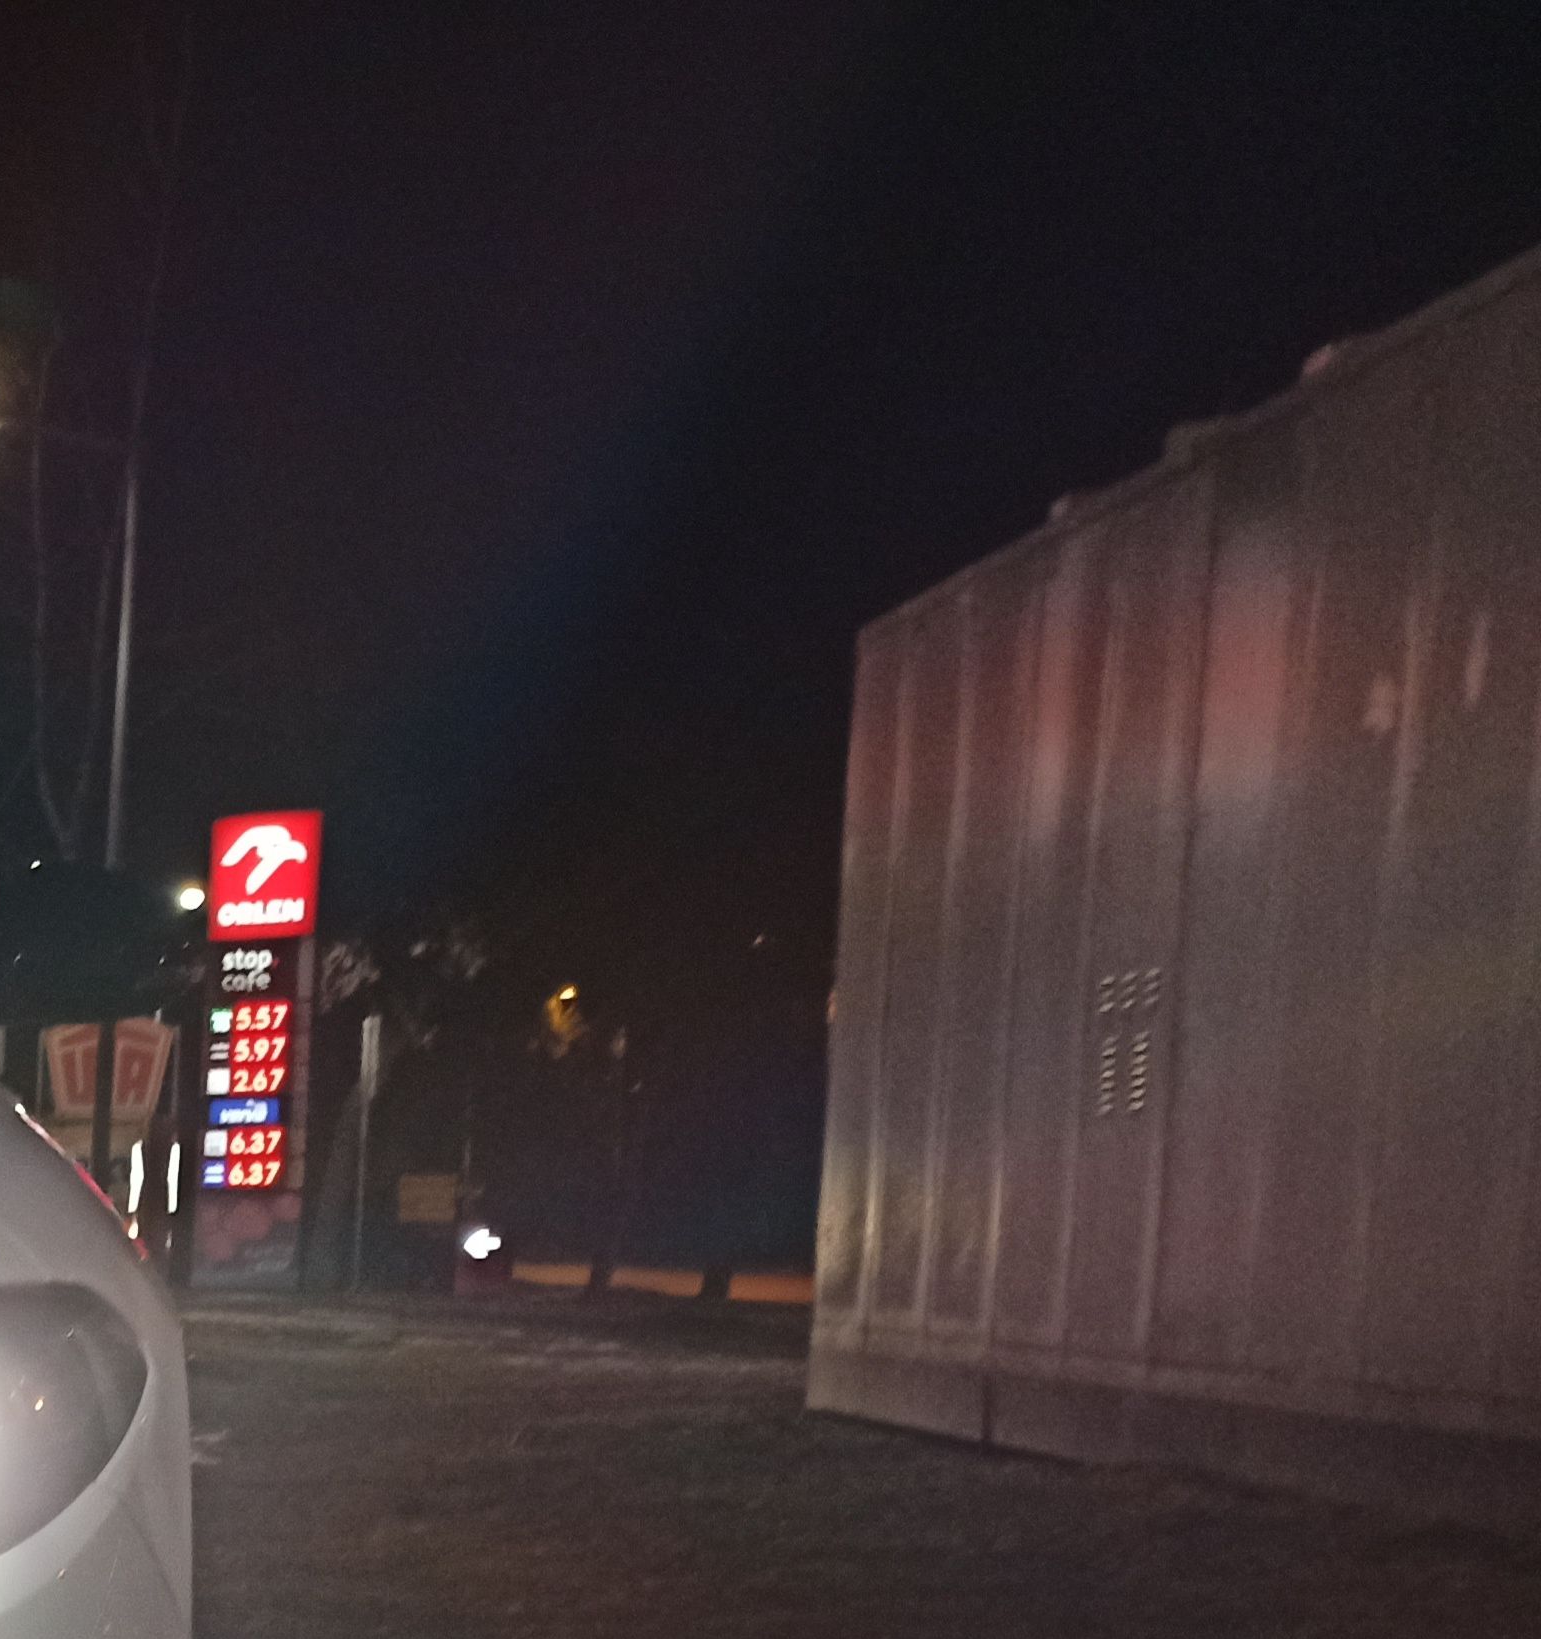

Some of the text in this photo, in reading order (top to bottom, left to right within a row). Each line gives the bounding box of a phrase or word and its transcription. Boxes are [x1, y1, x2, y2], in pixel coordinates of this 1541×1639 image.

[217, 897, 305, 927] ORLEN
[222, 947, 273, 975] stop
[236, 1004, 288, 1031] 5.57
[233, 1036, 286, 1062] 5.97
[233, 1067, 285, 1092] 2.67
[229, 1130, 282, 1155] 6.37
[227, 1161, 281, 1186] 6.37
